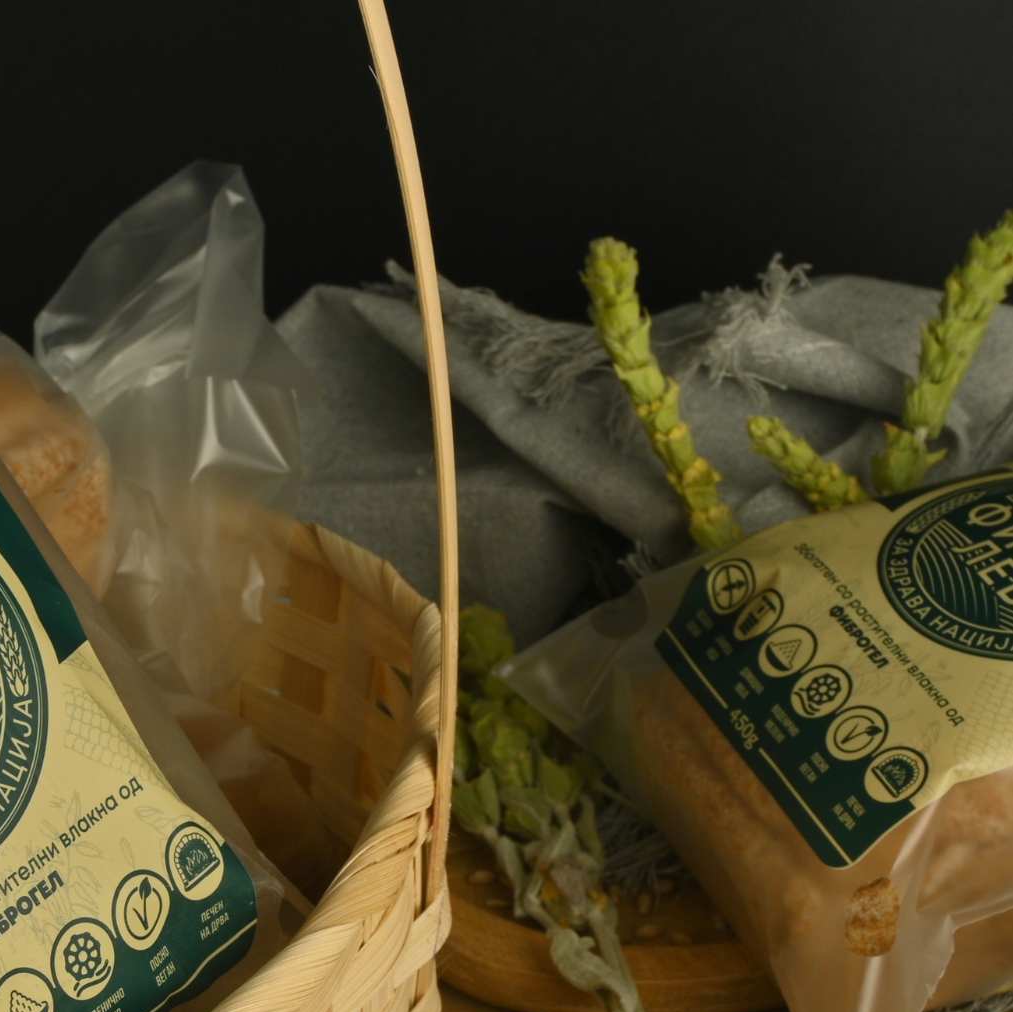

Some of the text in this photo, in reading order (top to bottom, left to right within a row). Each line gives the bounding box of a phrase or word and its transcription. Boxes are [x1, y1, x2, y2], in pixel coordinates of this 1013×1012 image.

[889, 536, 1013, 653] ЗА ЗДРАВА НАЦИЈ
[829, 605, 890, 669] ФИБРОГЕЛ
[907, 665, 949, 708] влакна
[945, 705, 965, 728] од
[728, 707, 760, 751] 450g
[59, 794, 119, 849] влакна
[118, 776, 144, 800] од
[199, 912, 230, 941] НА ДРВА
[200, 900, 225, 923] ПЕЧЕН
[149, 945, 172, 972] ПОСНО
[155, 961, 177, 987] ВЕГАН
